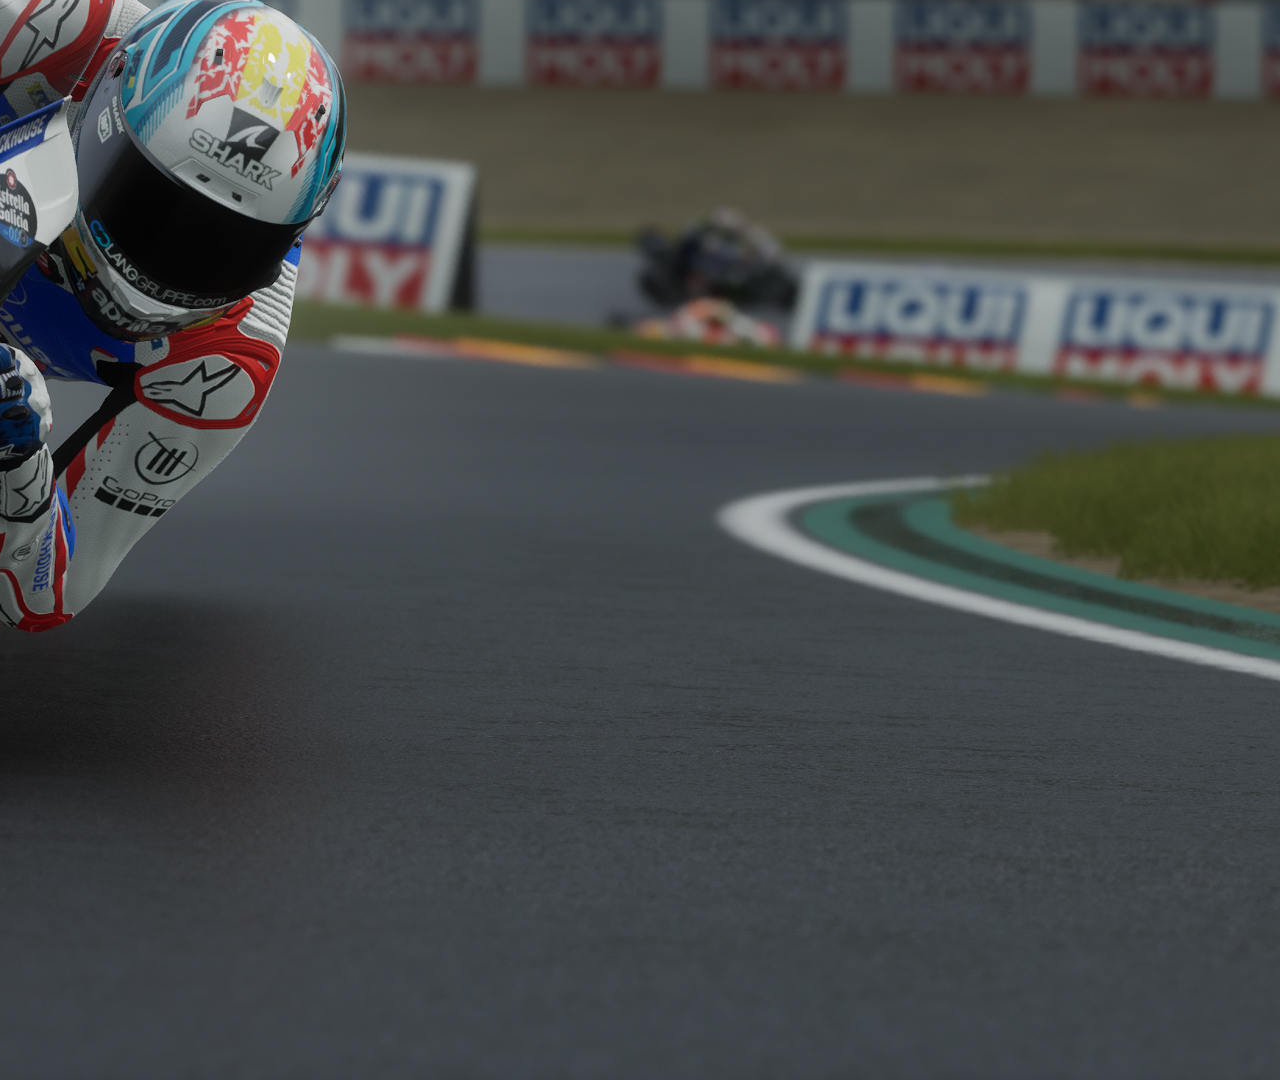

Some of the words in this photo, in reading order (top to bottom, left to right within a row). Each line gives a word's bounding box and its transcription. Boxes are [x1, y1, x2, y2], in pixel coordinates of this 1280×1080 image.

[112, 95, 125, 134] SHARK
[189, 128, 282, 191] SHARK
[104, 242, 228, 308] LANGGRUPPE.com
[91, 287, 167, 334] aprilia
[828, 285, 1016, 341] LIQUI
[1073, 295, 1263, 354] LIQUI
[102, 475, 176, 508] GoPro
[32, 492, 57, 591] CKHOUSE
